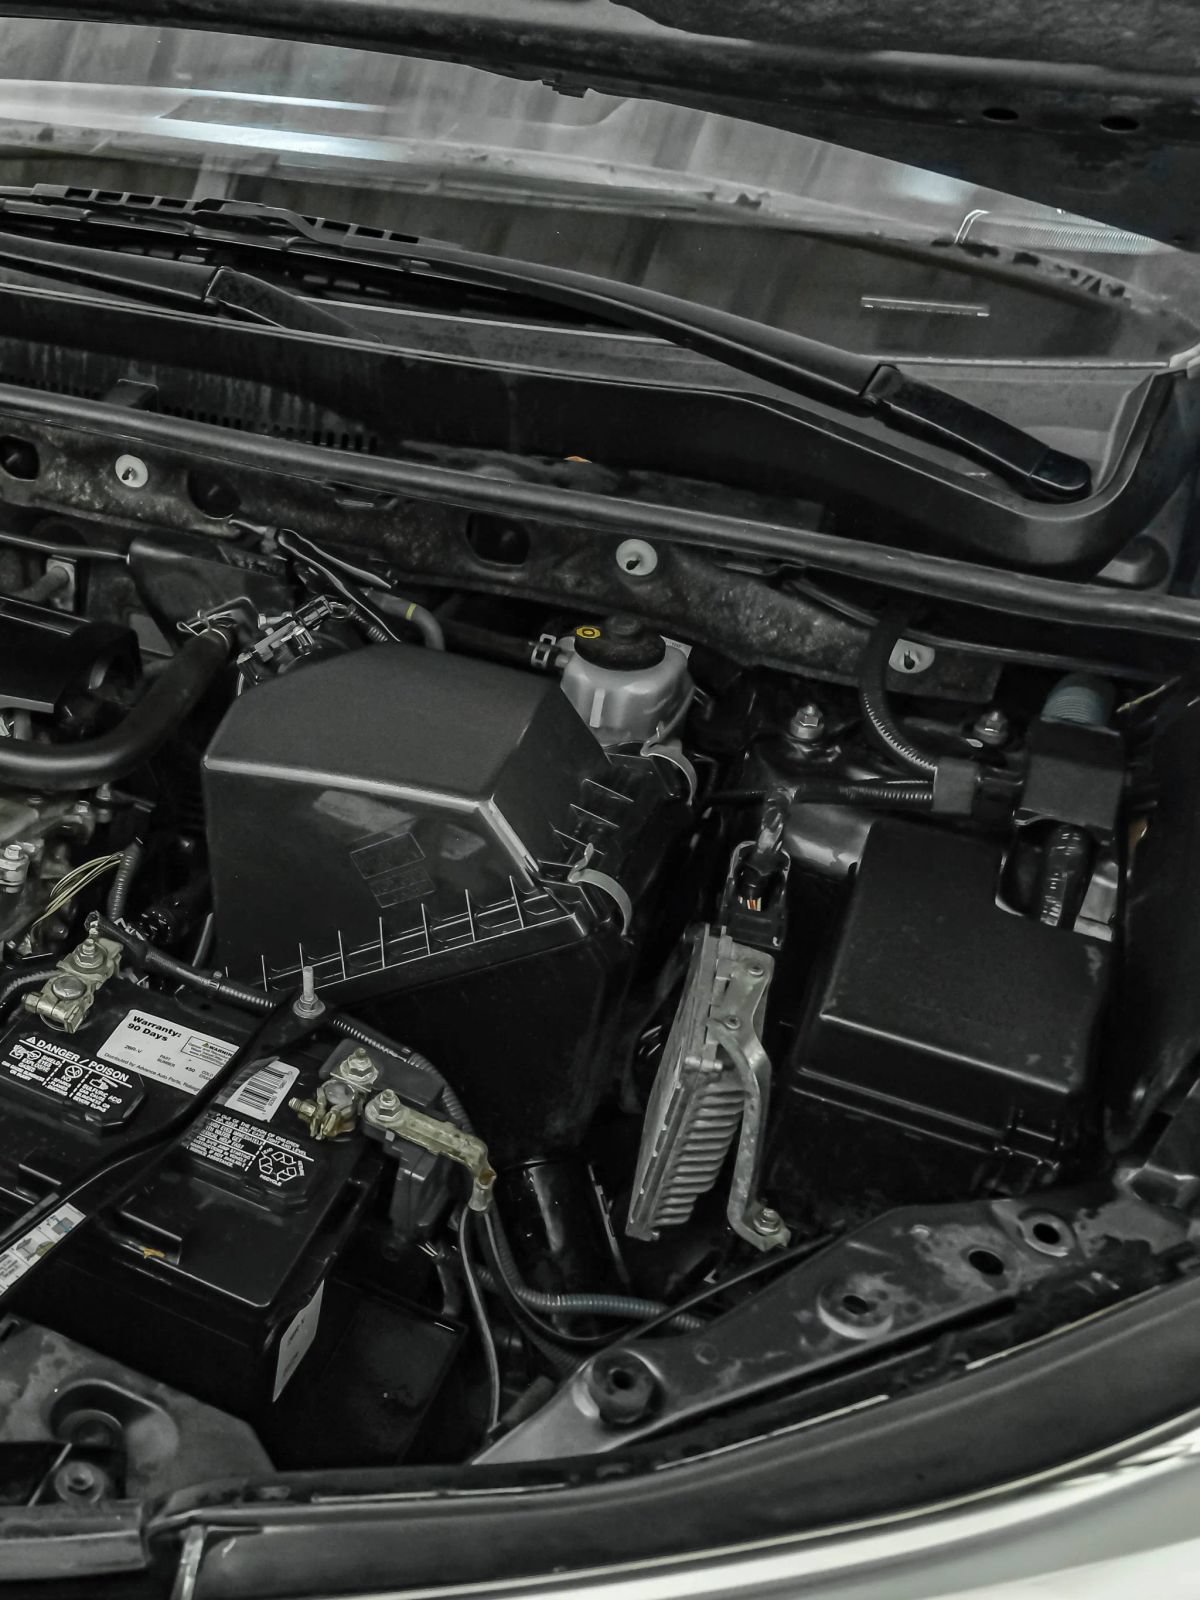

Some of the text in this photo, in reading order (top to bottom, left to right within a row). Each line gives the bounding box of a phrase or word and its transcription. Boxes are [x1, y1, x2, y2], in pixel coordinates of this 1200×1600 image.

[128, 1023, 168, 1041] 90 Days
[133, 1016, 181, 1037] Warranty:
[37, 1040, 80, 1061] DANGER
[88, 1061, 129, 1081] POISON
[207, 1046, 232, 1056] WARNIN
[104, 1052, 129, 1064] Distributed
[136, 1065, 156, 1075] Advance
